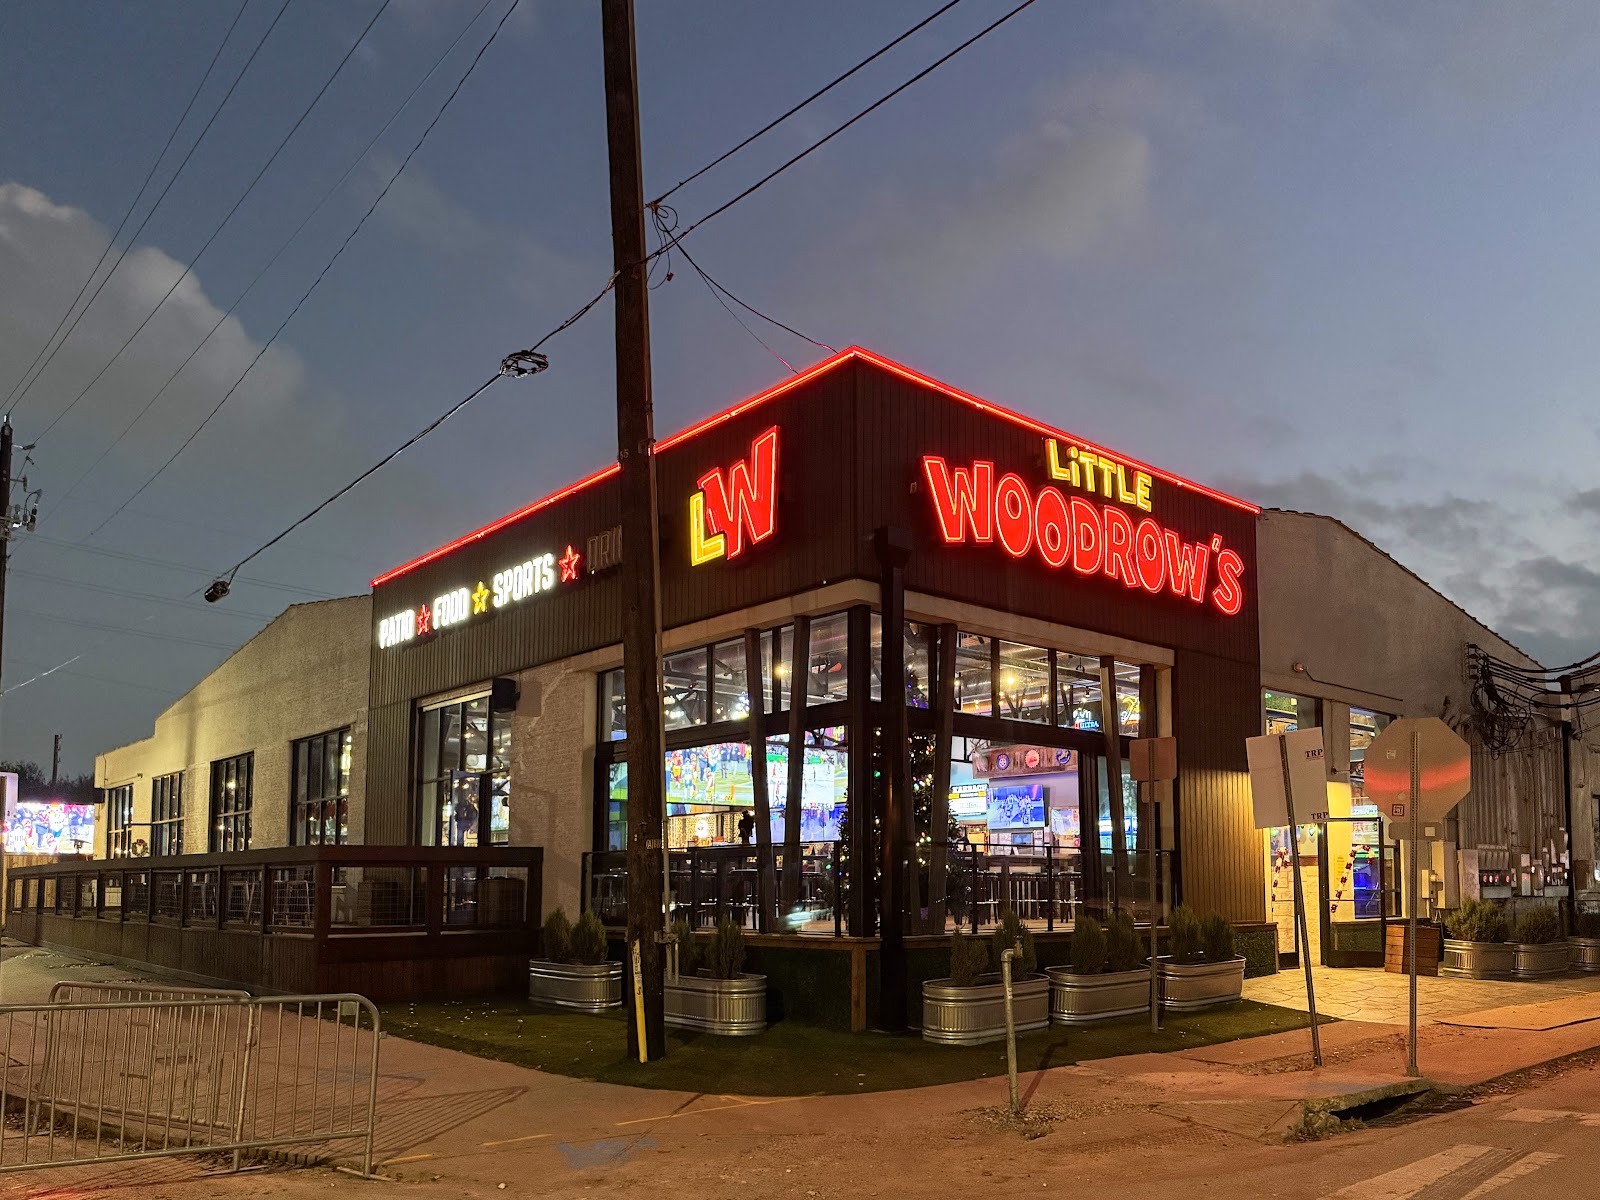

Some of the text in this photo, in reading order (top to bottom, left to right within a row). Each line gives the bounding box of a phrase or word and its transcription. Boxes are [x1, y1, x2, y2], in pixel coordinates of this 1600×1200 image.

[689, 425, 780, 567] LW
[922, 455, 1245, 616] WOODROW'S
[378, 608, 415, 650] PATIO
[432, 586, 470, 631] FOOD
[492, 552, 556, 608] SPORTS
[1305, 748, 1324, 758] TRP
[1311, 811, 1329, 821] TRP
